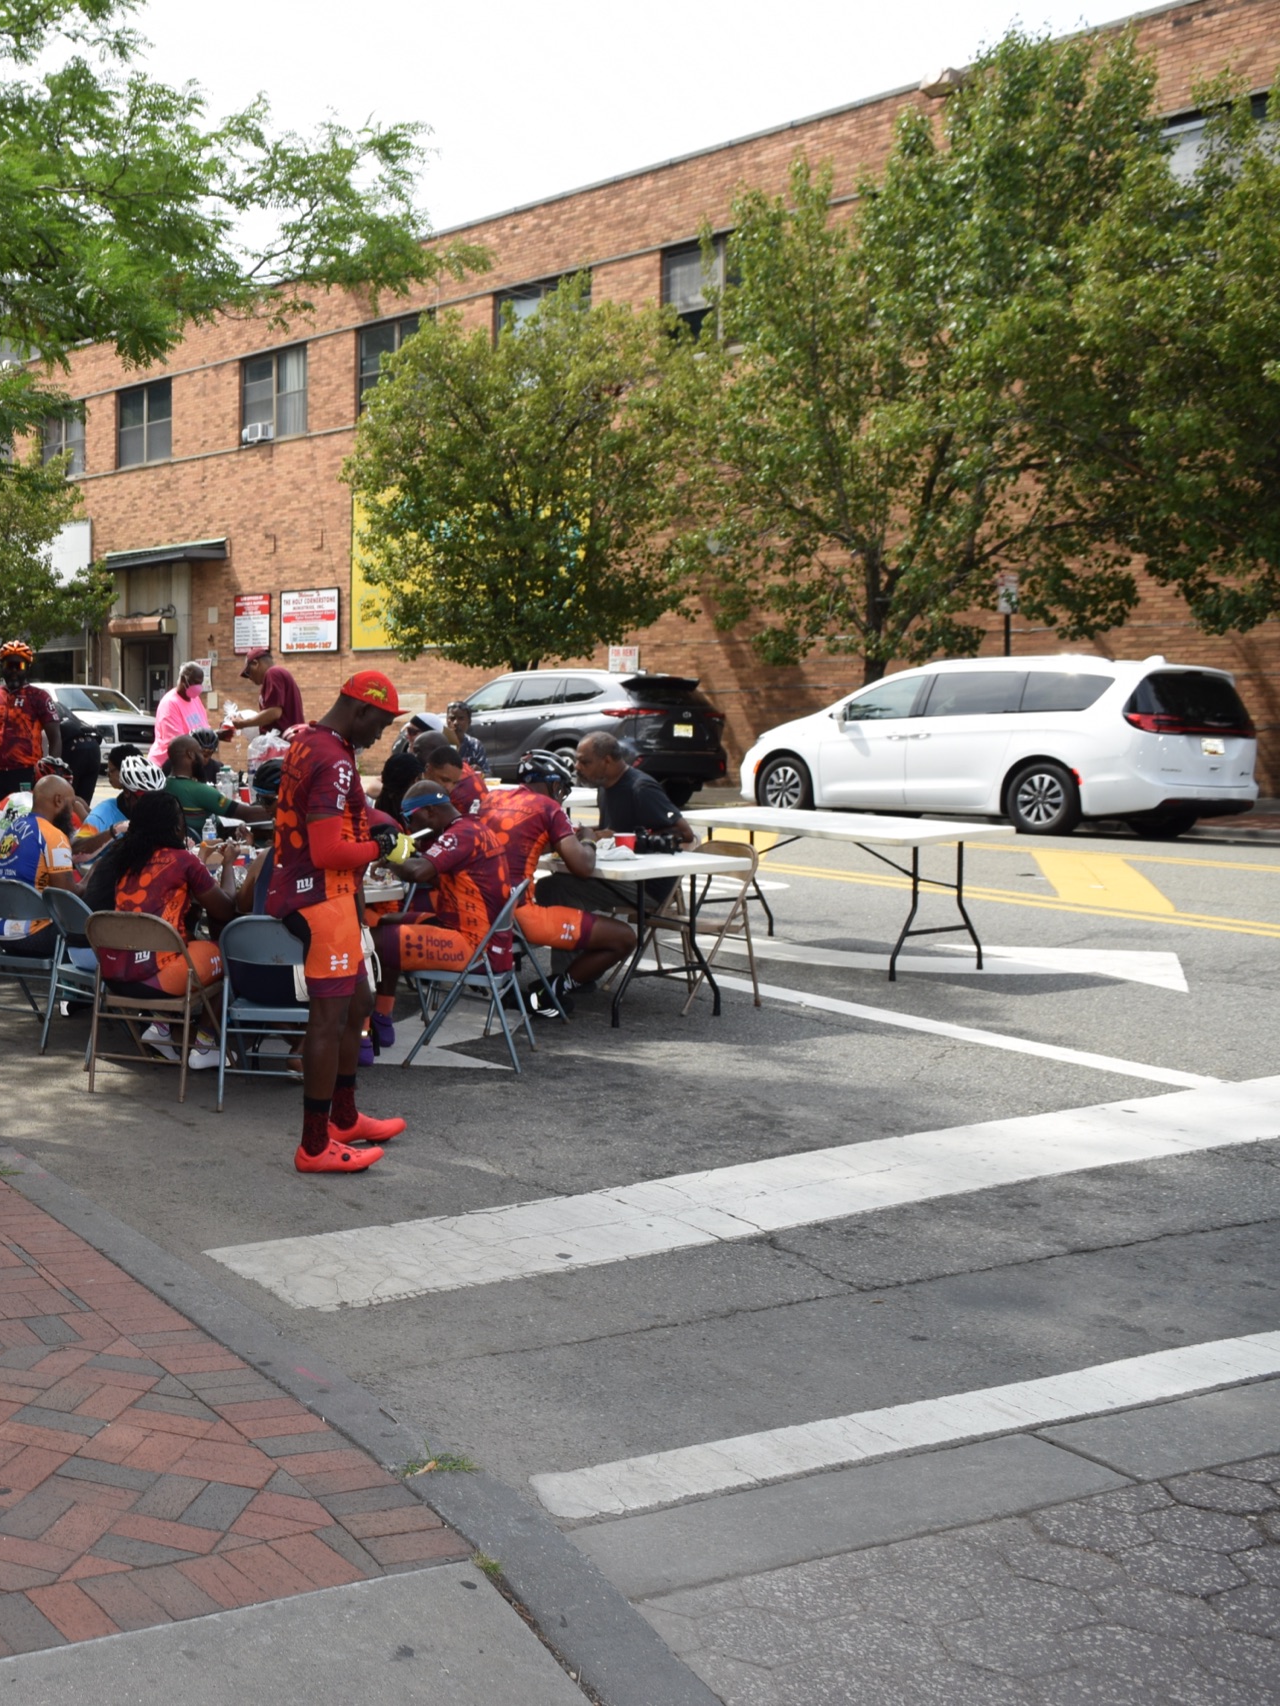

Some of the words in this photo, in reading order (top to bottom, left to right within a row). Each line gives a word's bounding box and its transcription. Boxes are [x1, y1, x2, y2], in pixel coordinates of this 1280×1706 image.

[426, 936, 453, 950] Hope
[426, 950, 436, 960] Is
[437, 951, 465, 961] Loud
